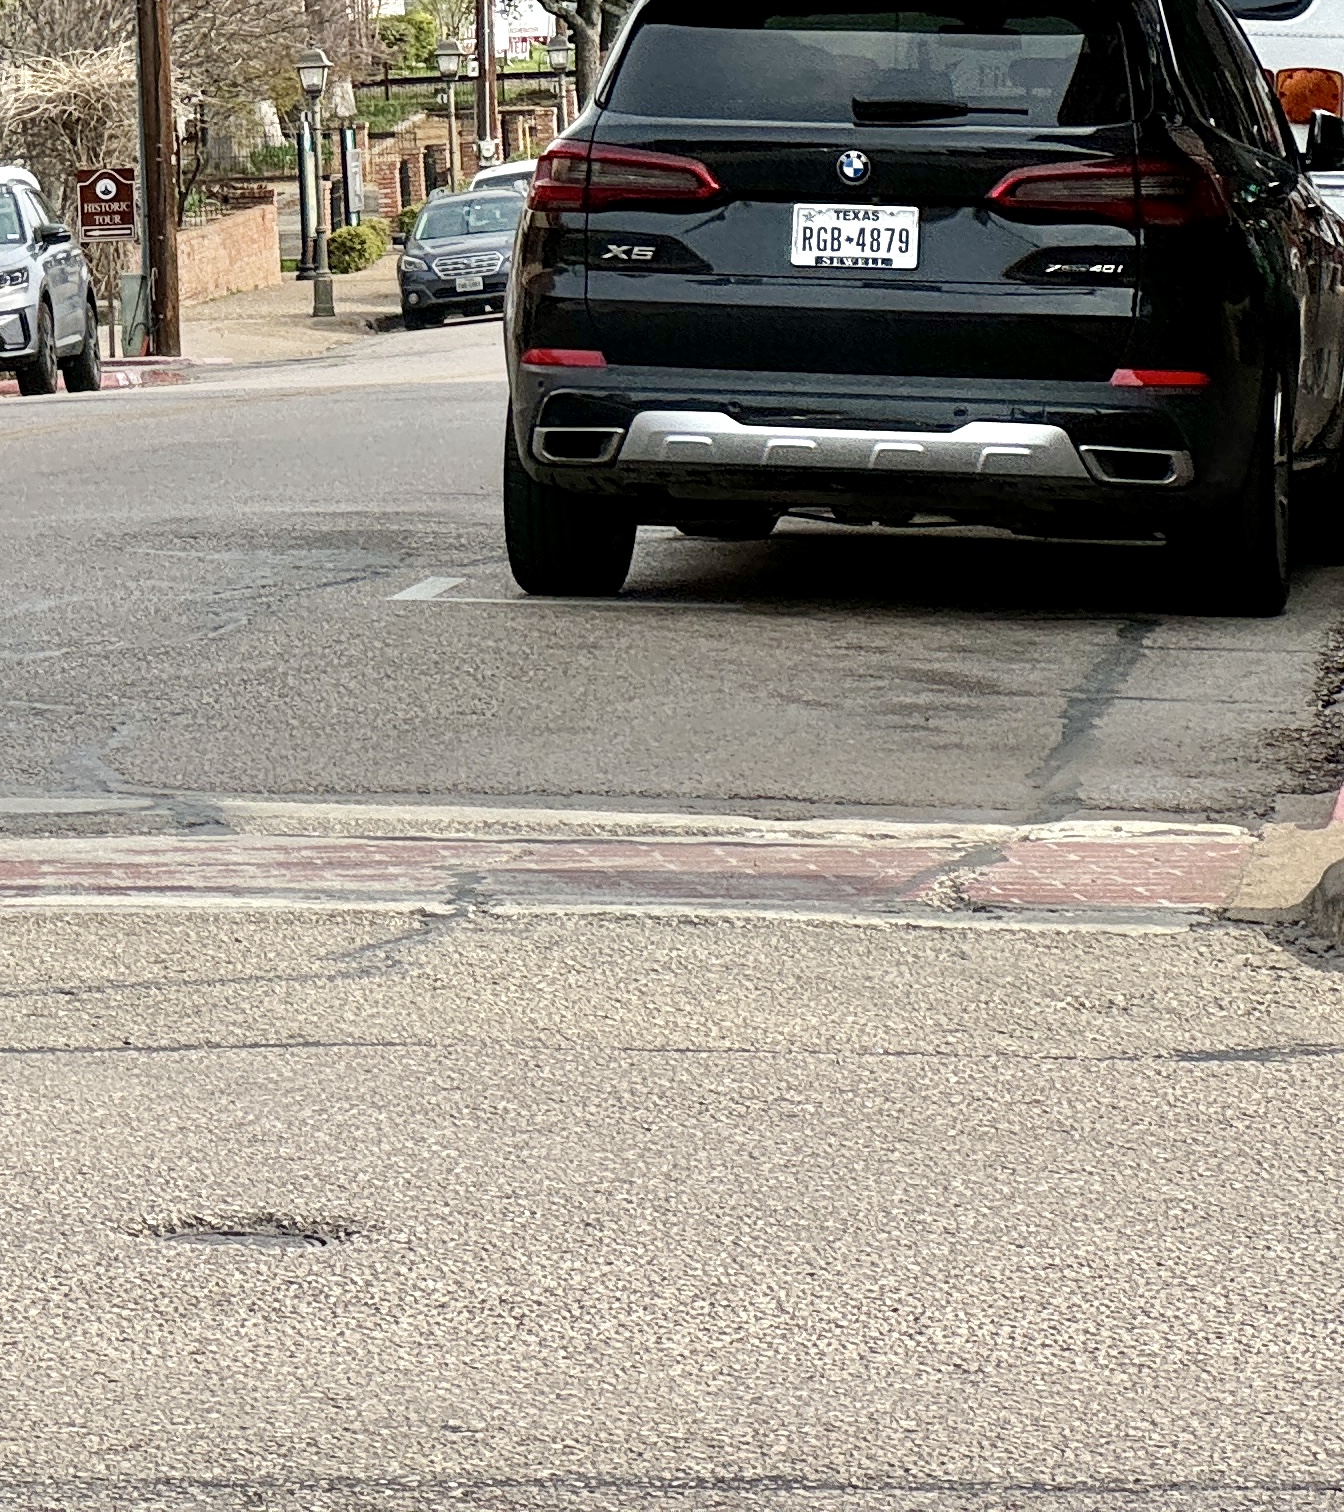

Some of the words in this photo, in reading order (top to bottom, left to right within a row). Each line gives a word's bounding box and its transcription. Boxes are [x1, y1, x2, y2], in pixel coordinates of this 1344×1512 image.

[83, 202, 131, 213] HISTORIC
[94, 215, 122, 225] TOUR
[833, 209, 880, 222] TEXAS
[600, 244, 656, 260] X5
